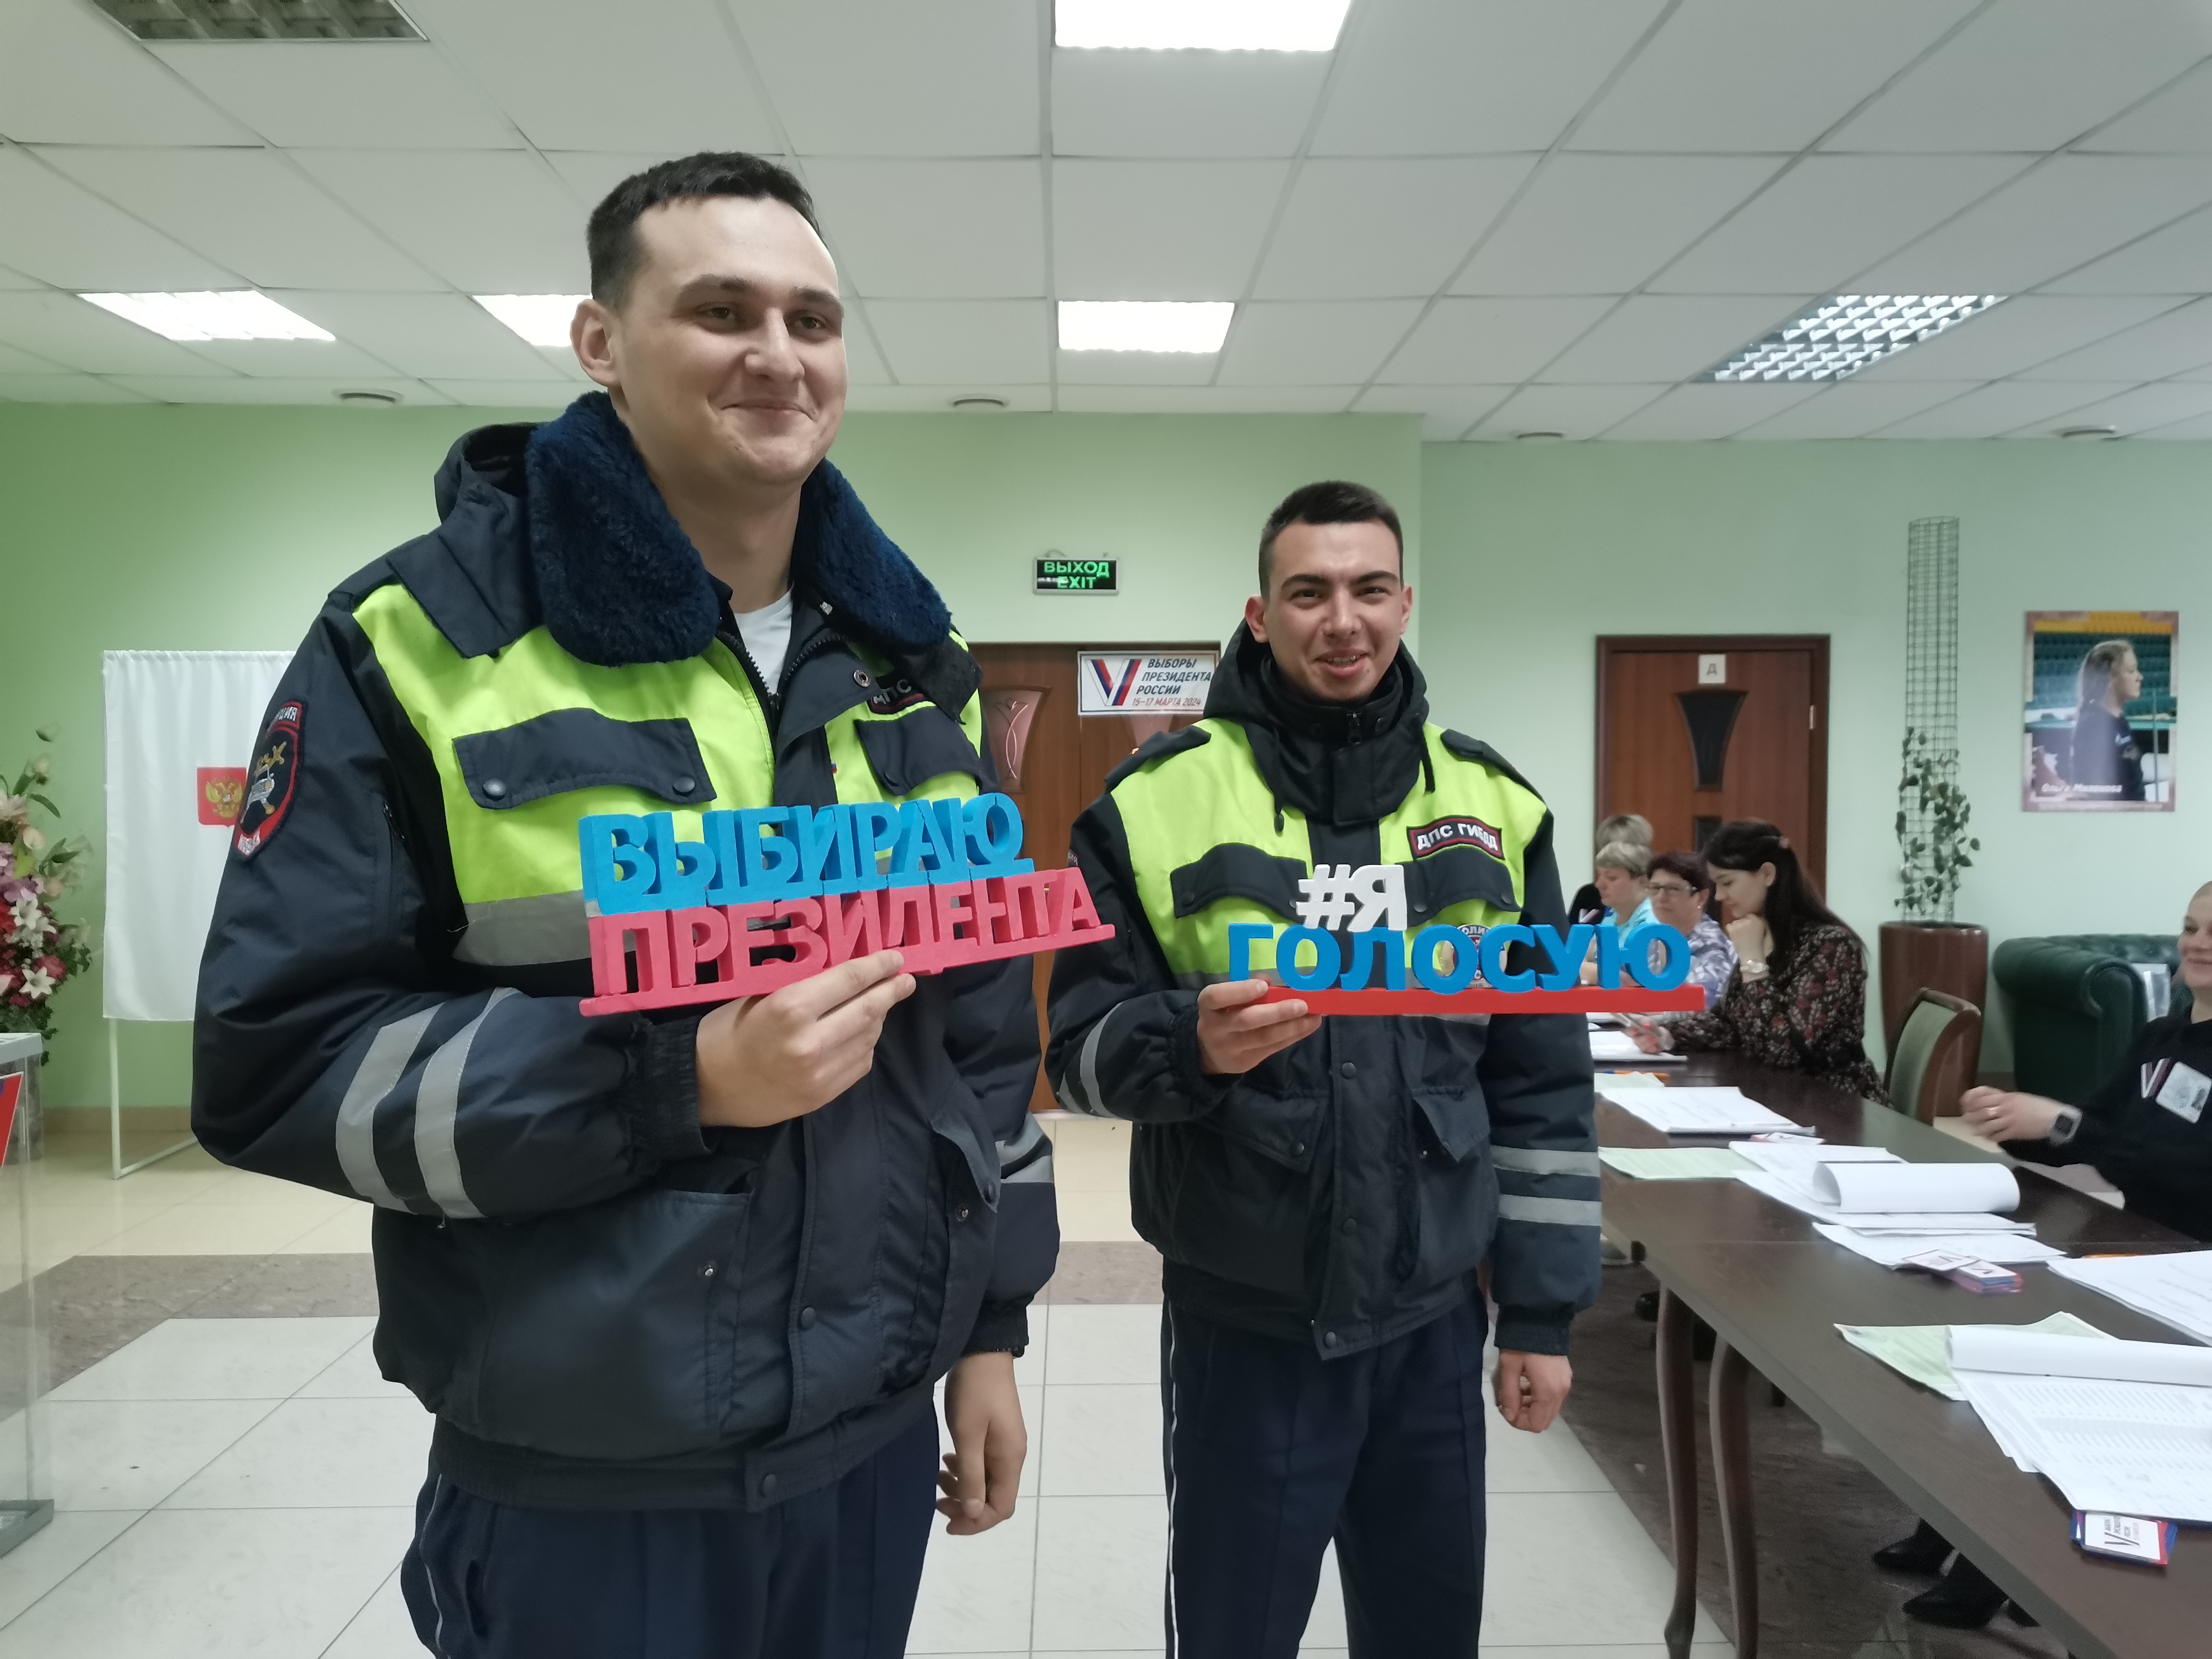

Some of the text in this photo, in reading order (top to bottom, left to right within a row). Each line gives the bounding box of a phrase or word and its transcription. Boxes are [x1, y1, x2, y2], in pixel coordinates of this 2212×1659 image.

[1044, 561, 1109, 577] ВЫХОД
[1057, 576, 1097, 589] EXIT
[1147, 658, 1197, 668] ВЫБОРЫ
[1141, 671, 1212, 682] ПРЕЗИДЕНТА
[1136, 685, 1181, 695] РОССИИ
[1154, 697, 1181, 706] МАРТА
[1182, 697, 1202, 706] 2024
[1417, 823, 1499, 851] ДПС ГИБДД
[581, 793, 1032, 916] ВЫБИРАЮ
[1296, 864, 1408, 932] #Я
[1228, 923, 1691, 994] ГОЛОСУЮ
